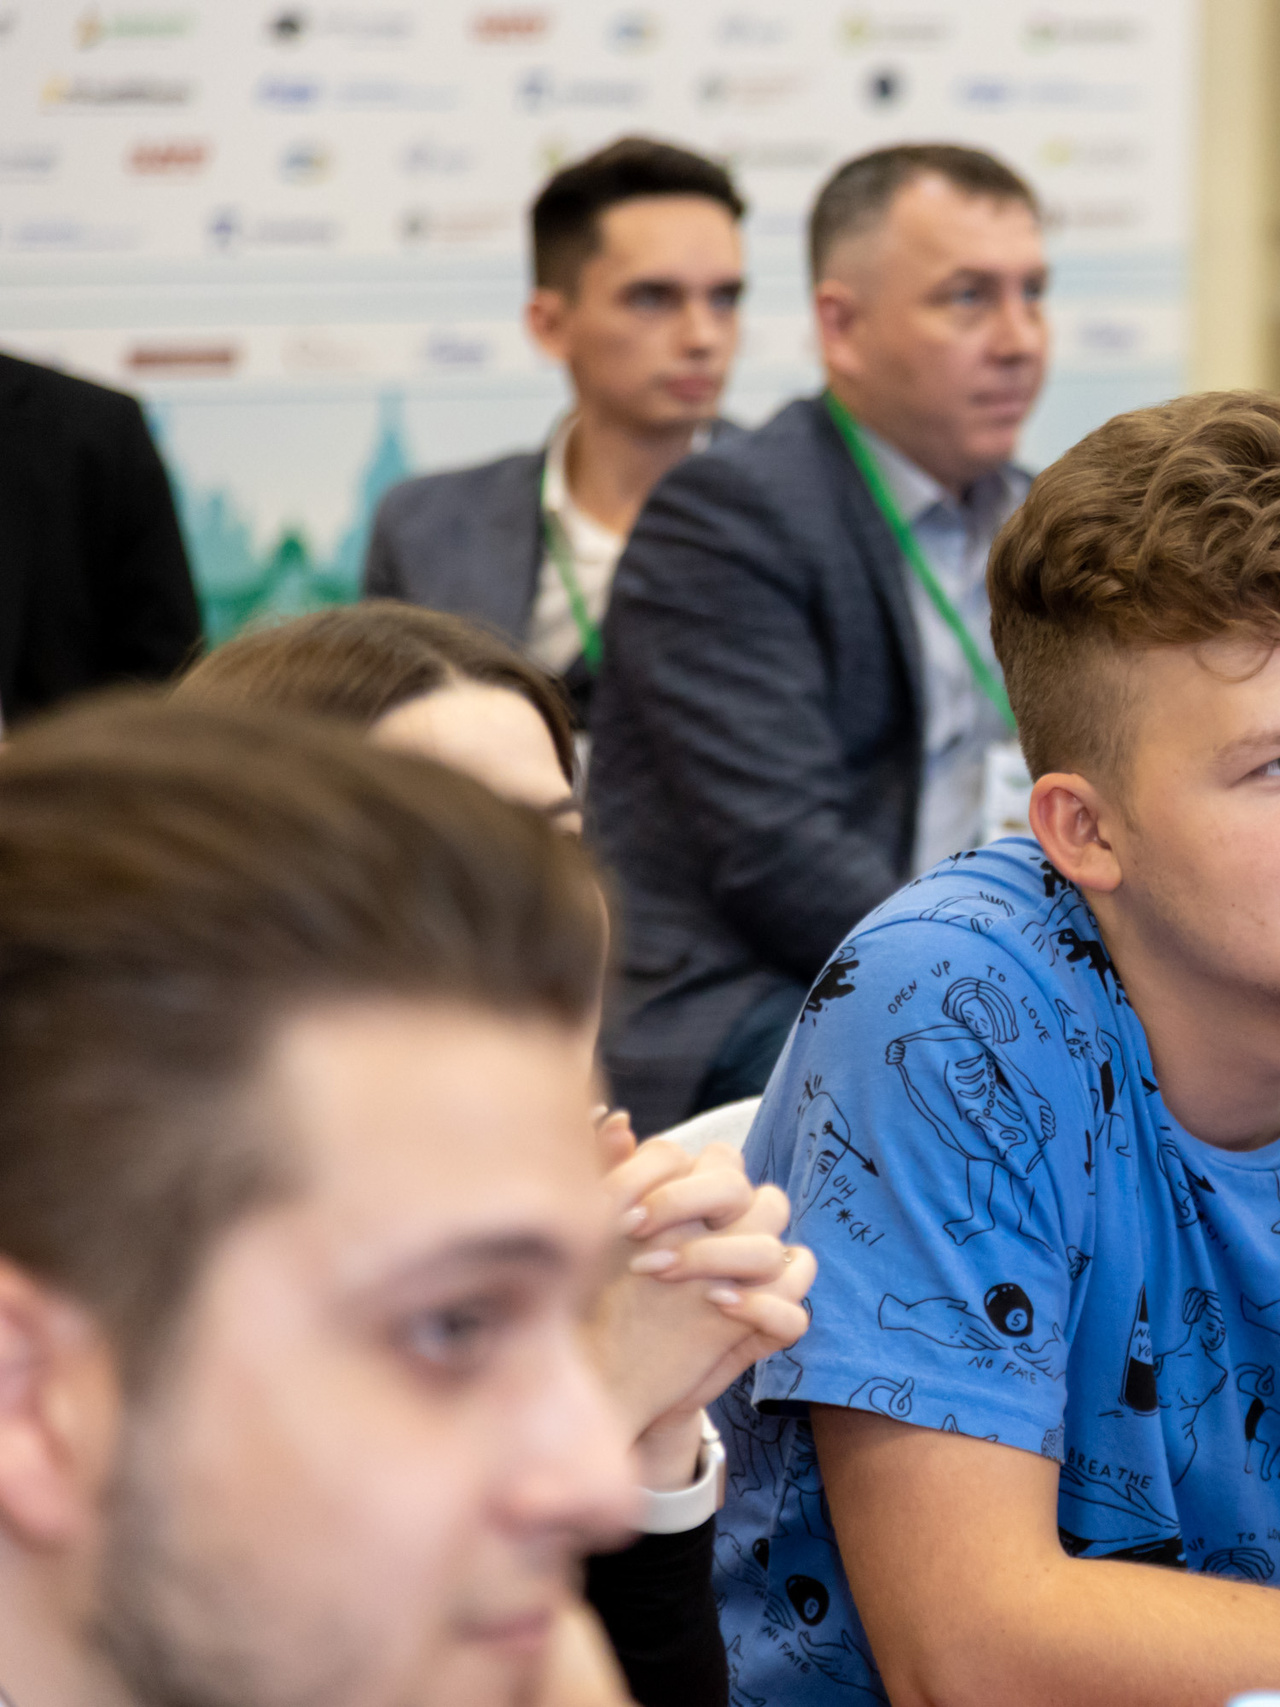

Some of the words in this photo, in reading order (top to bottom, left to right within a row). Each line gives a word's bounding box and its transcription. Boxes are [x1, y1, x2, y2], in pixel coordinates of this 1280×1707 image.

[888, 980, 917, 1014] OPEN
[931, 960, 951, 978] UP
[987, 965, 1006, 982] TO
[1020, 996, 1051, 1044] LOVE
[833, 1174, 858, 1200] OH
[967, 1356, 993, 1369] NO
[1002, 1361, 1037, 1385] FATE
[1067, 1447, 1153, 1490] BREATHE
[1236, 1532, 1256, 1545] TO
